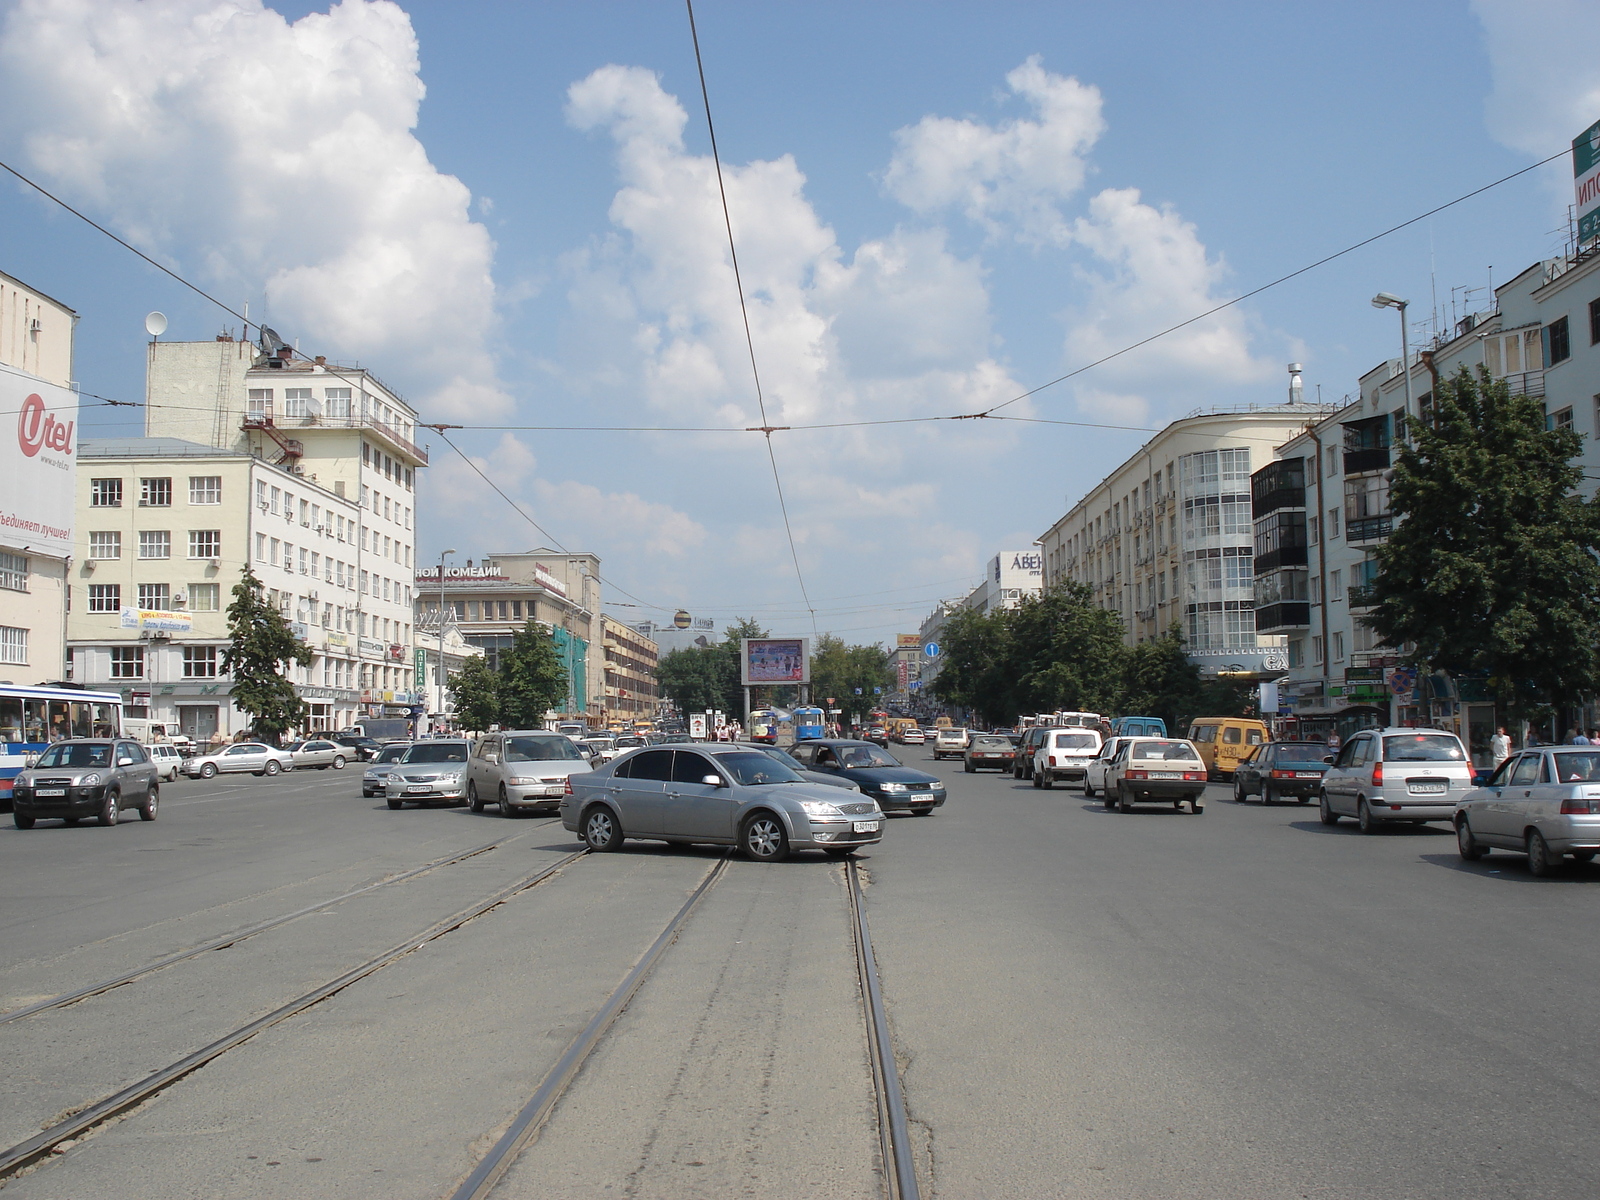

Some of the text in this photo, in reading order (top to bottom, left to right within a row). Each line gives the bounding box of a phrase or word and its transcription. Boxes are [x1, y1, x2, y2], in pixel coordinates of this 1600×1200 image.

[18, 393, 73, 457] Utel
[41, 524, 70, 540] лучшее!
[444, 566, 502, 577] КОМЕДИИ
